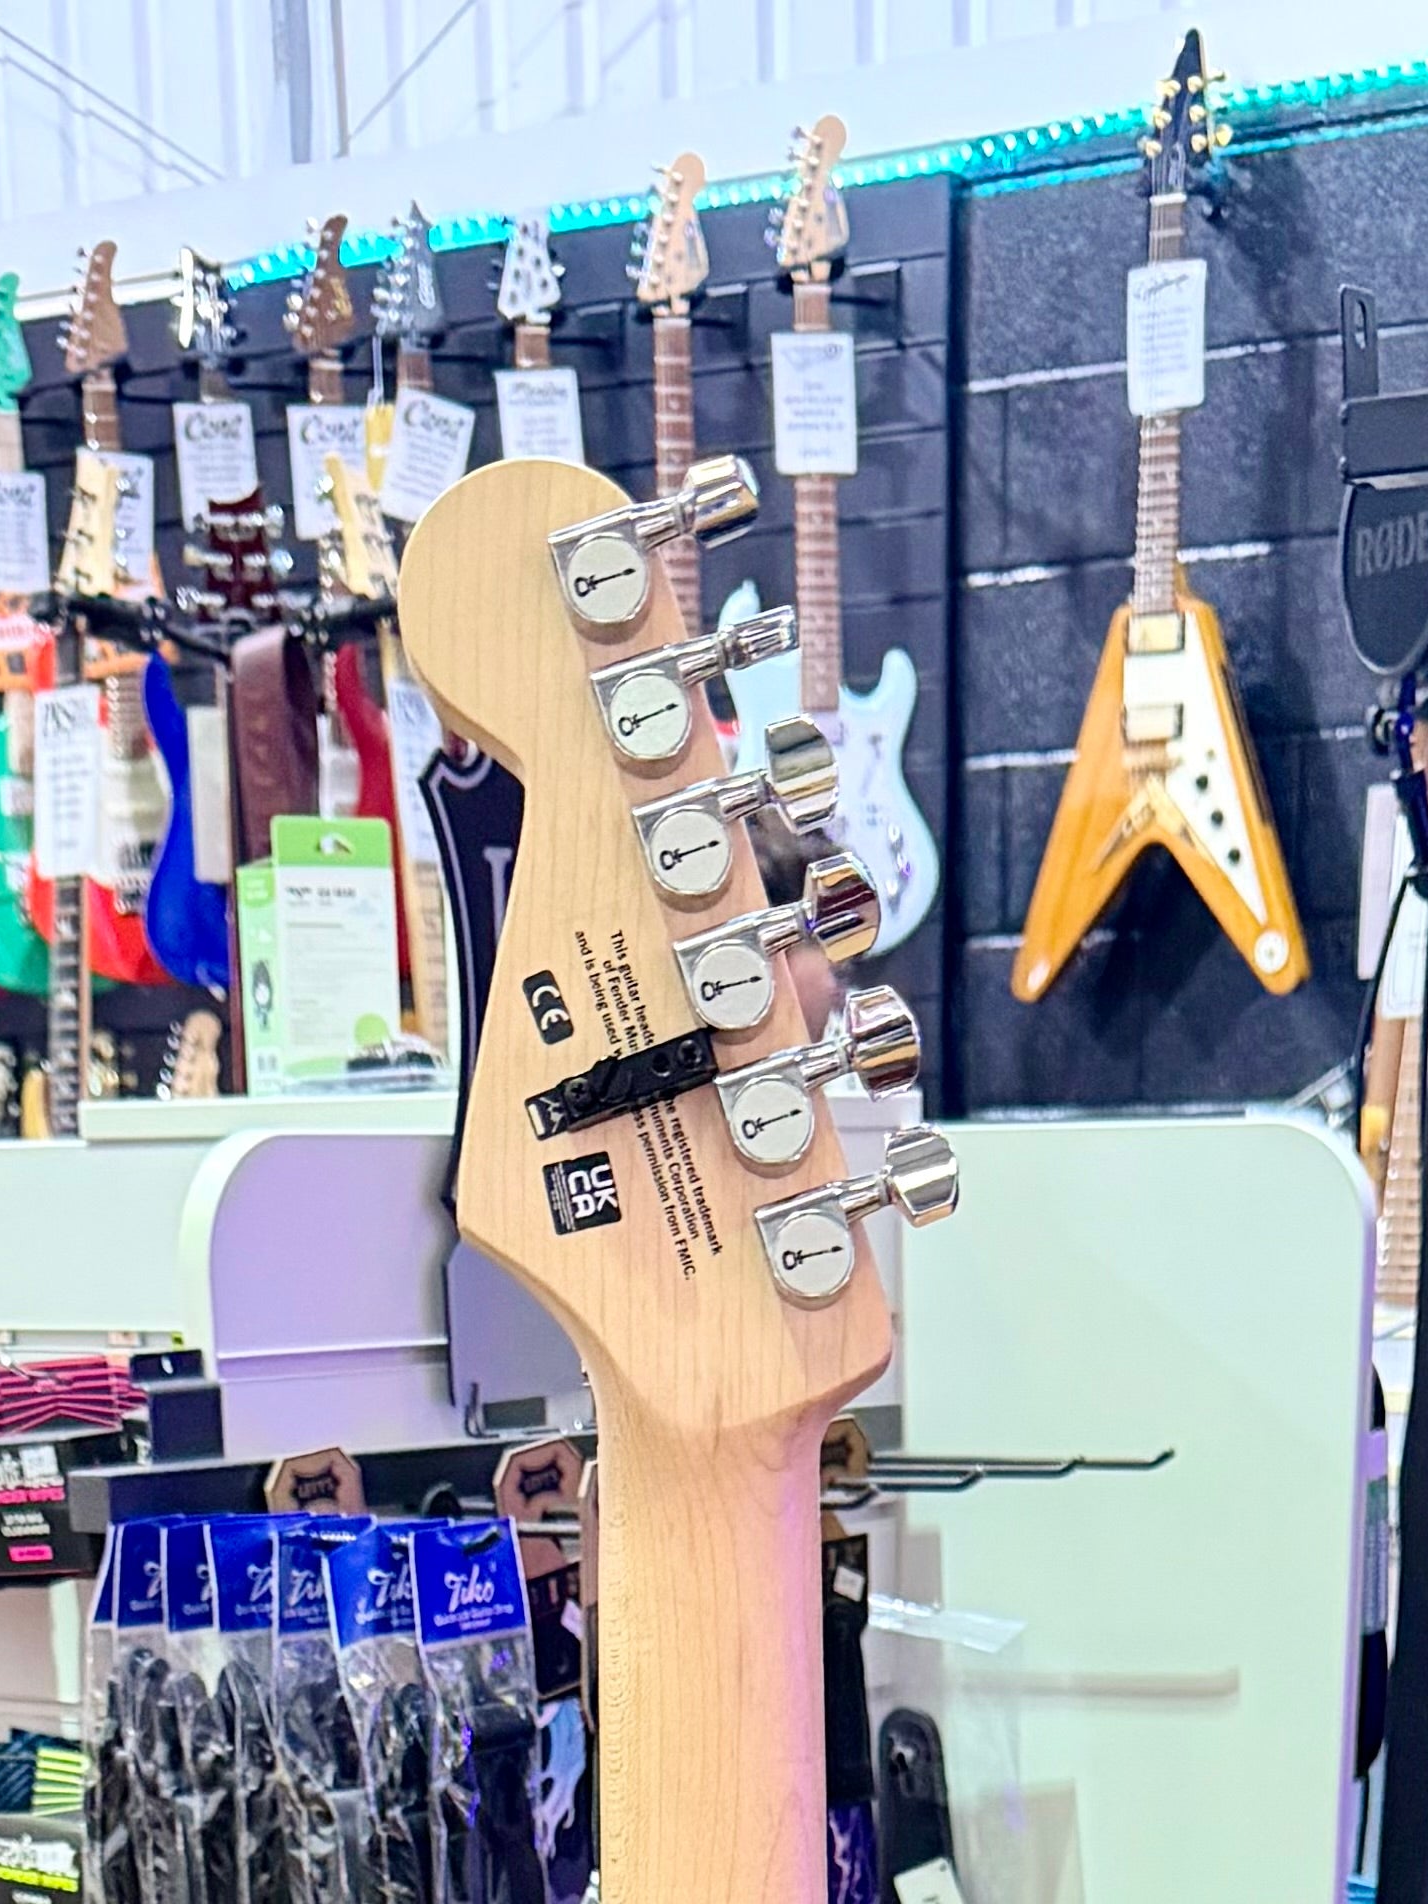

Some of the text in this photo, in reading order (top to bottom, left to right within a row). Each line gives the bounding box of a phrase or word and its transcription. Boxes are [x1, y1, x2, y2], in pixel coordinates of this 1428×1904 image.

[575, 930, 593, 957] and
[584, 957, 596, 971] is
[611, 929, 627, 960] This
[602, 959, 616, 974] of
[618, 962, 641, 1003] guitar
[531, 984, 570, 1031] CE
[589, 973, 608, 1012] being
[607, 975, 631, 1025] Fender
[602, 1012, 622, 1045] used
[634, 1003, 657, 1047] heads
[649, 1103, 674, 1161] ruments
[670, 1118, 702, 1184] registered
[637, 1131, 671, 1203] permission
[664, 1204, 682, 1238] from
[668, 1161, 700, 1240] Corporation
[693, 1185, 724, 1256] trademark
[674, 1238, 697, 1281] FMIC.
